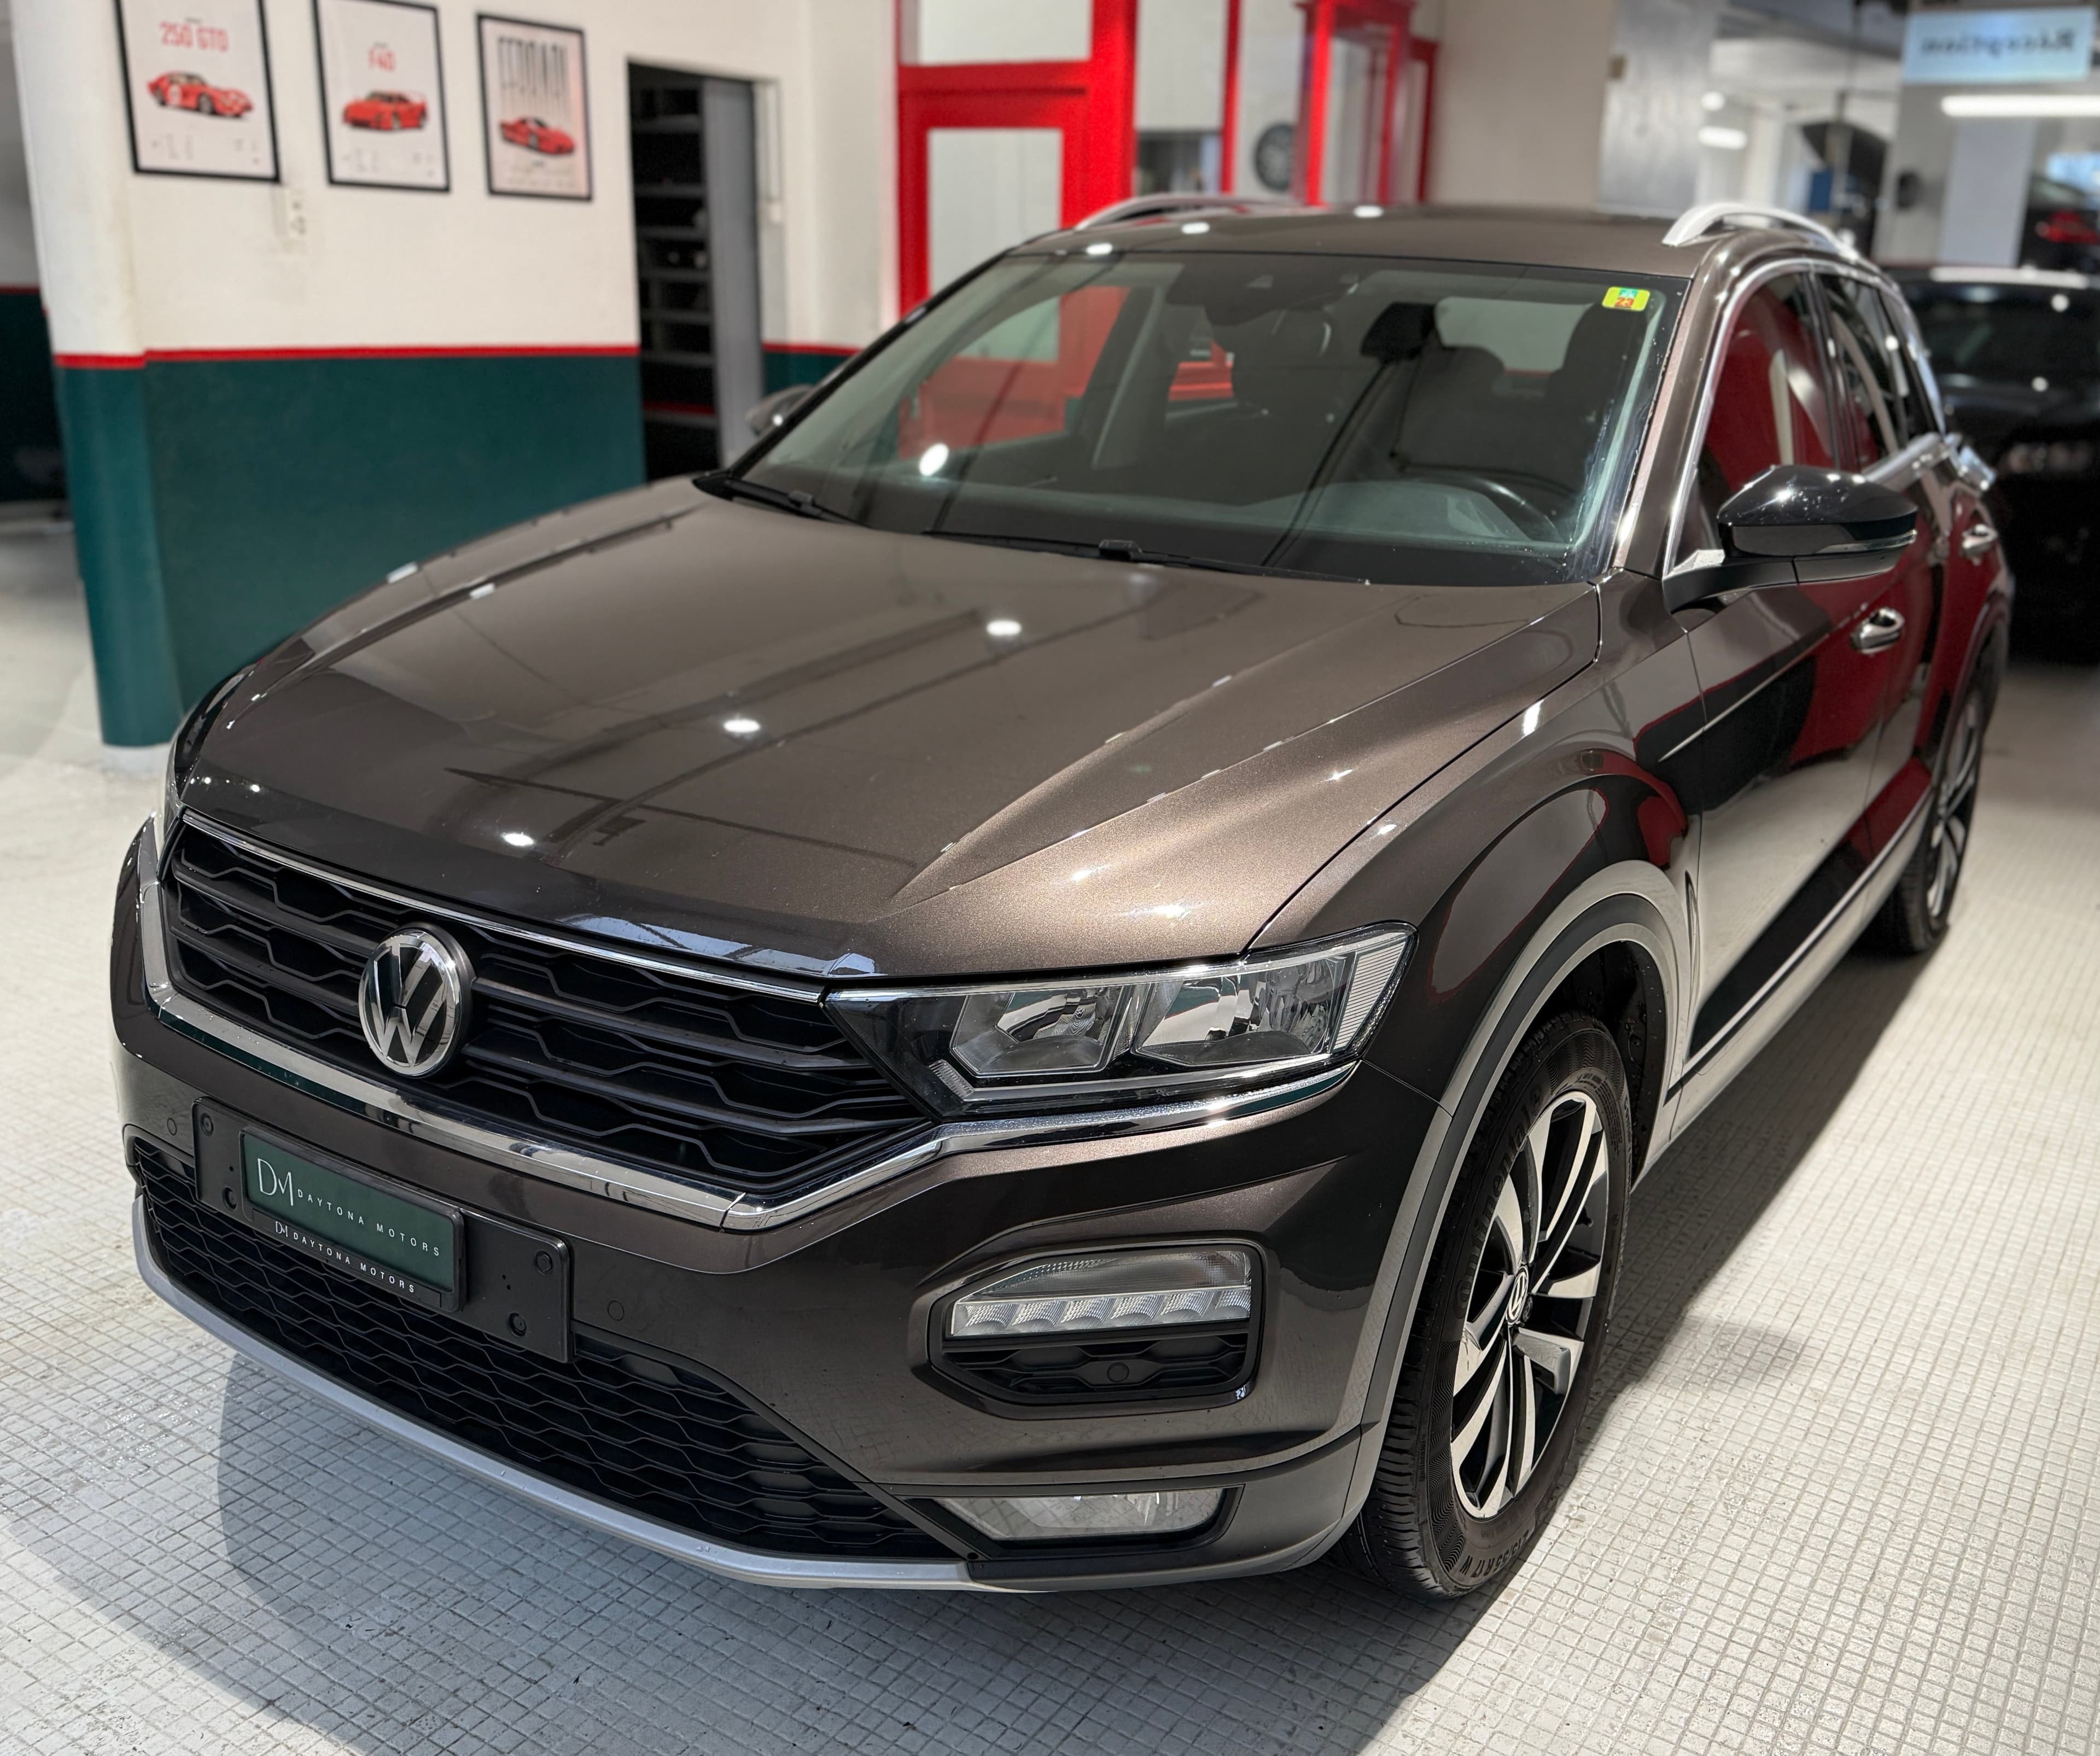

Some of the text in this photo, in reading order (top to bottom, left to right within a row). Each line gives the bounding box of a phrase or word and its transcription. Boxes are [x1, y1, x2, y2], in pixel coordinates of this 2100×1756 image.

[160, 20, 229, 53] 250 GTO
[368, 47, 396, 72] F40
[298, 1188, 364, 1225] DAYTONA
[376, 1223, 439, 1256] MOTORS
[293, 1232, 351, 1264] DAYTONA
[360, 1262, 414, 1293] MOTORS
